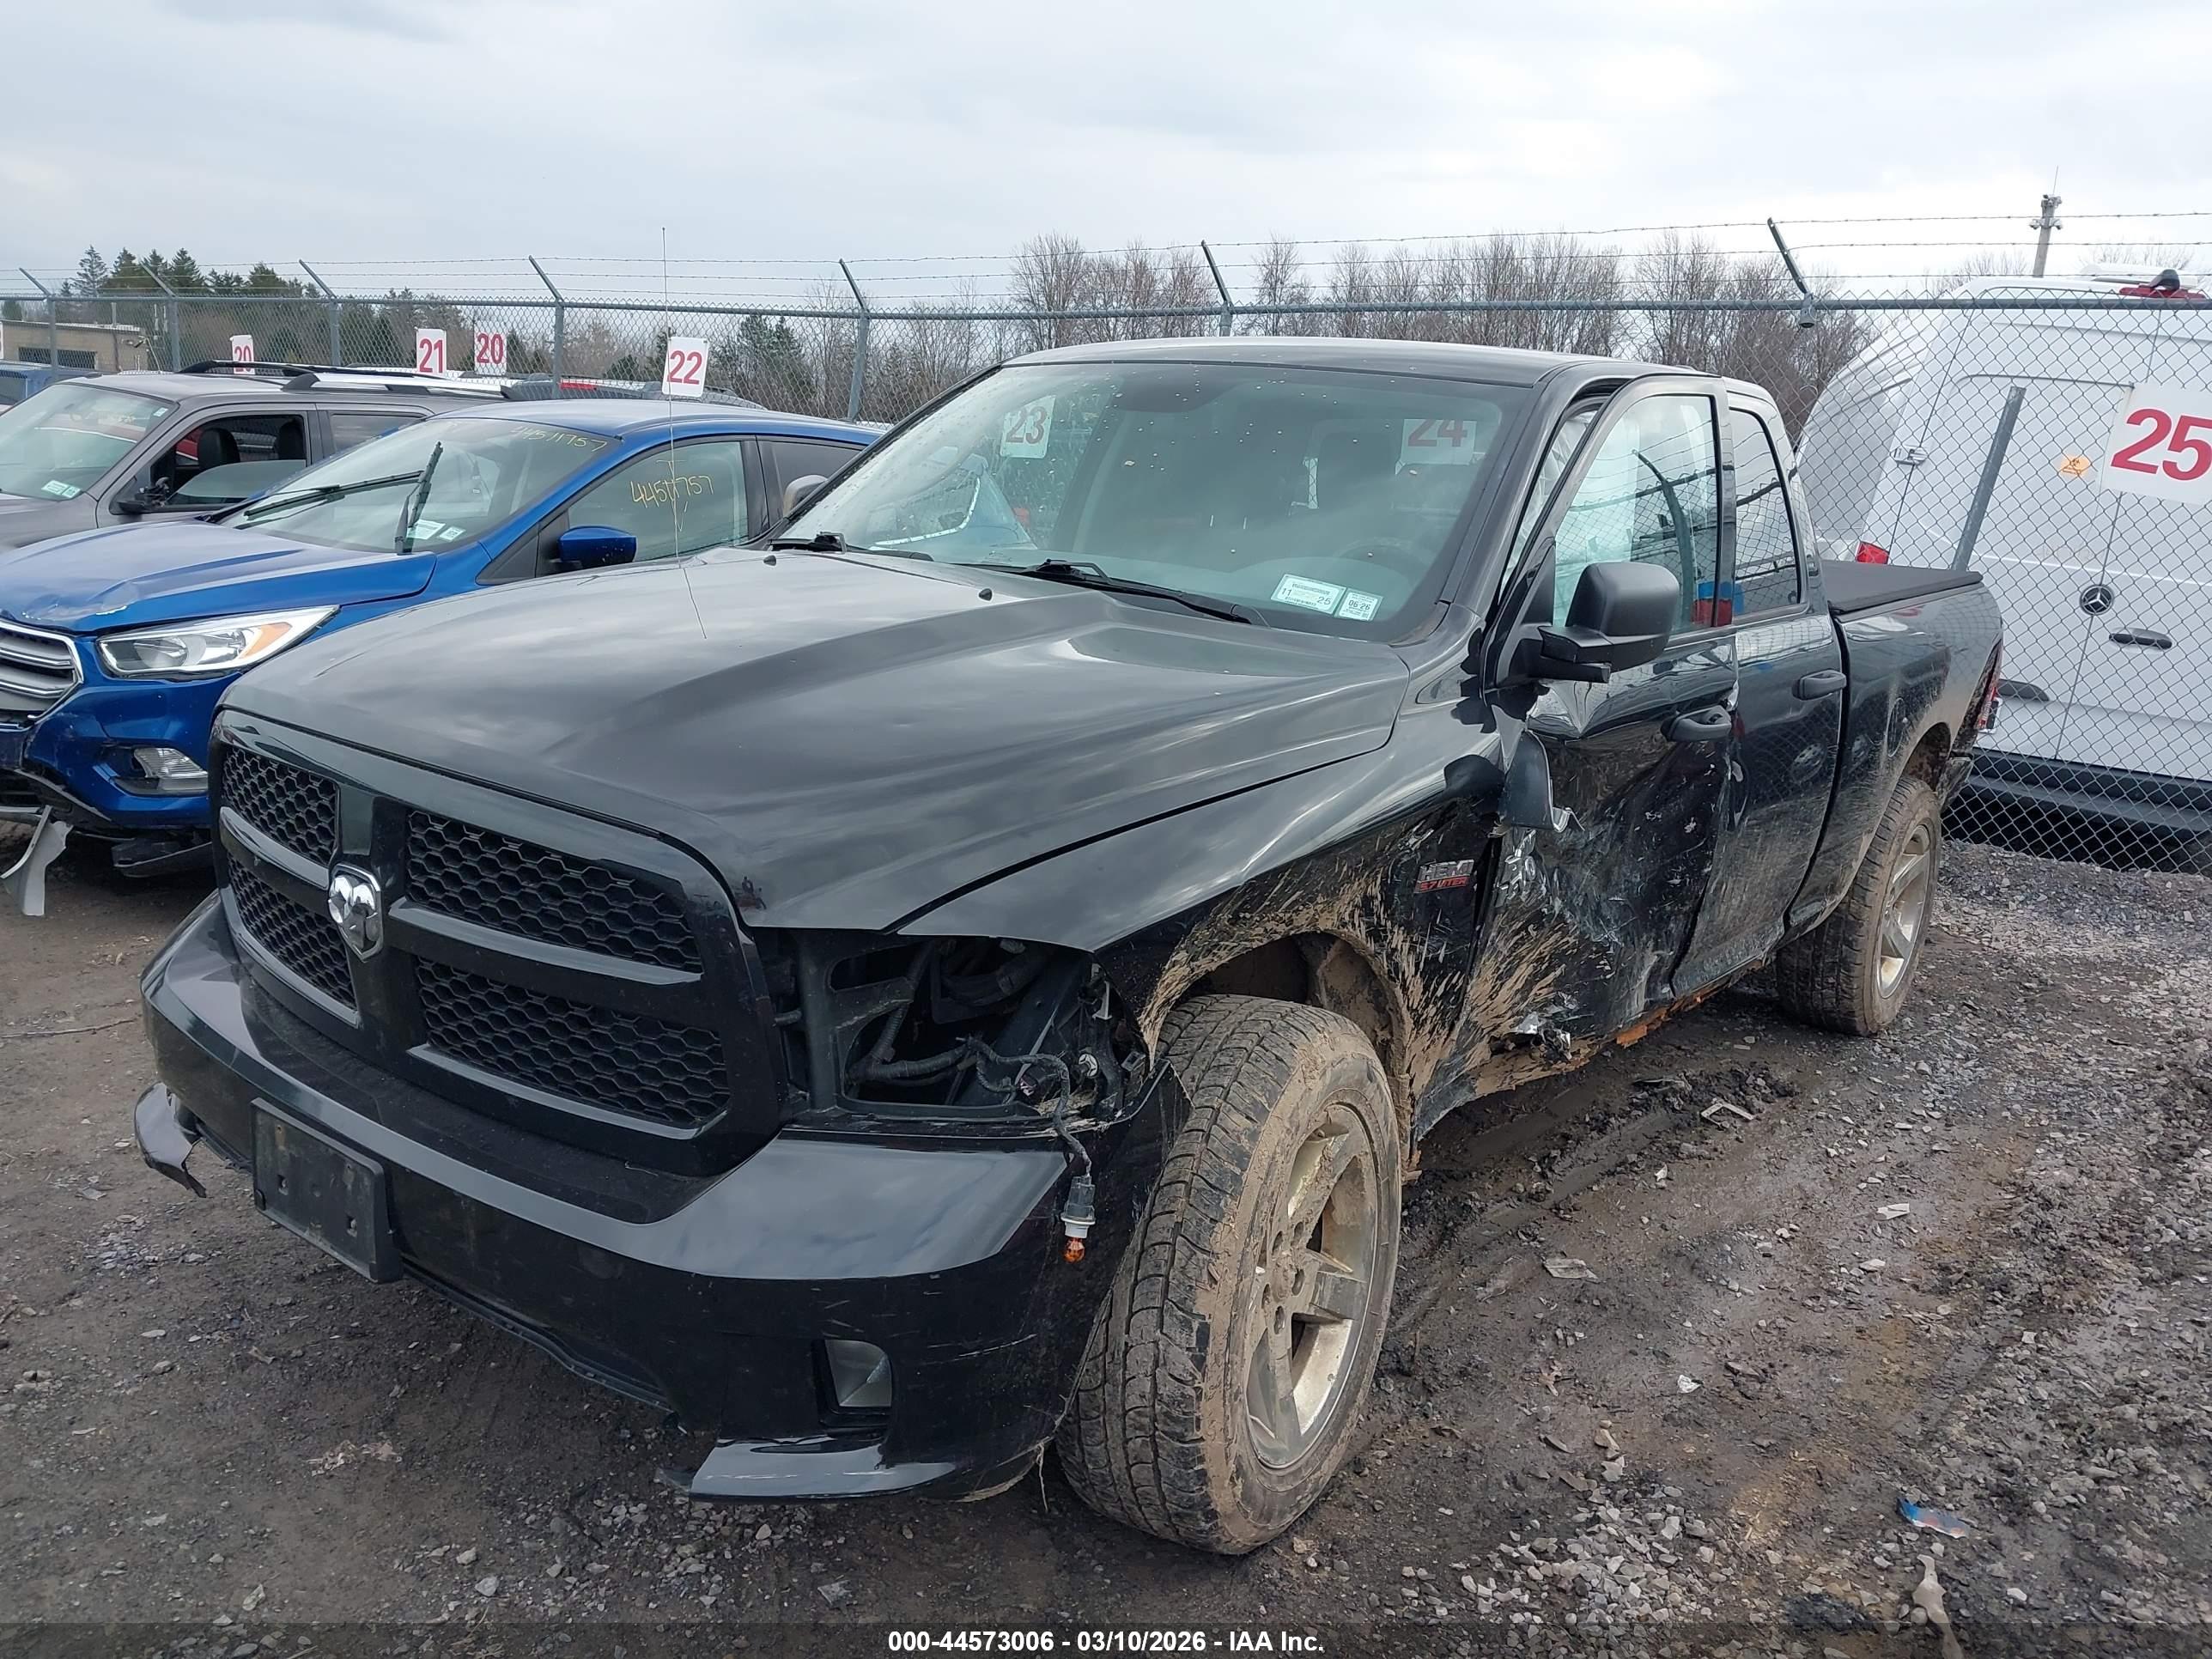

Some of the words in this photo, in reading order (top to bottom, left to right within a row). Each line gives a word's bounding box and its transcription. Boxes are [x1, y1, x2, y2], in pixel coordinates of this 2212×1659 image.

[234, 345, 252, 372] 20
[418, 337, 445, 374] 21
[477, 332, 504, 364] 20
[667, 349, 702, 386] 22
[1005, 405, 1048, 445] 23
[2110, 407, 2212, 482] 25
[1316, 596, 1332, 605] 25
[1418, 860, 1474, 881] HEMI
[1437, 878, 1468, 889] LITER
